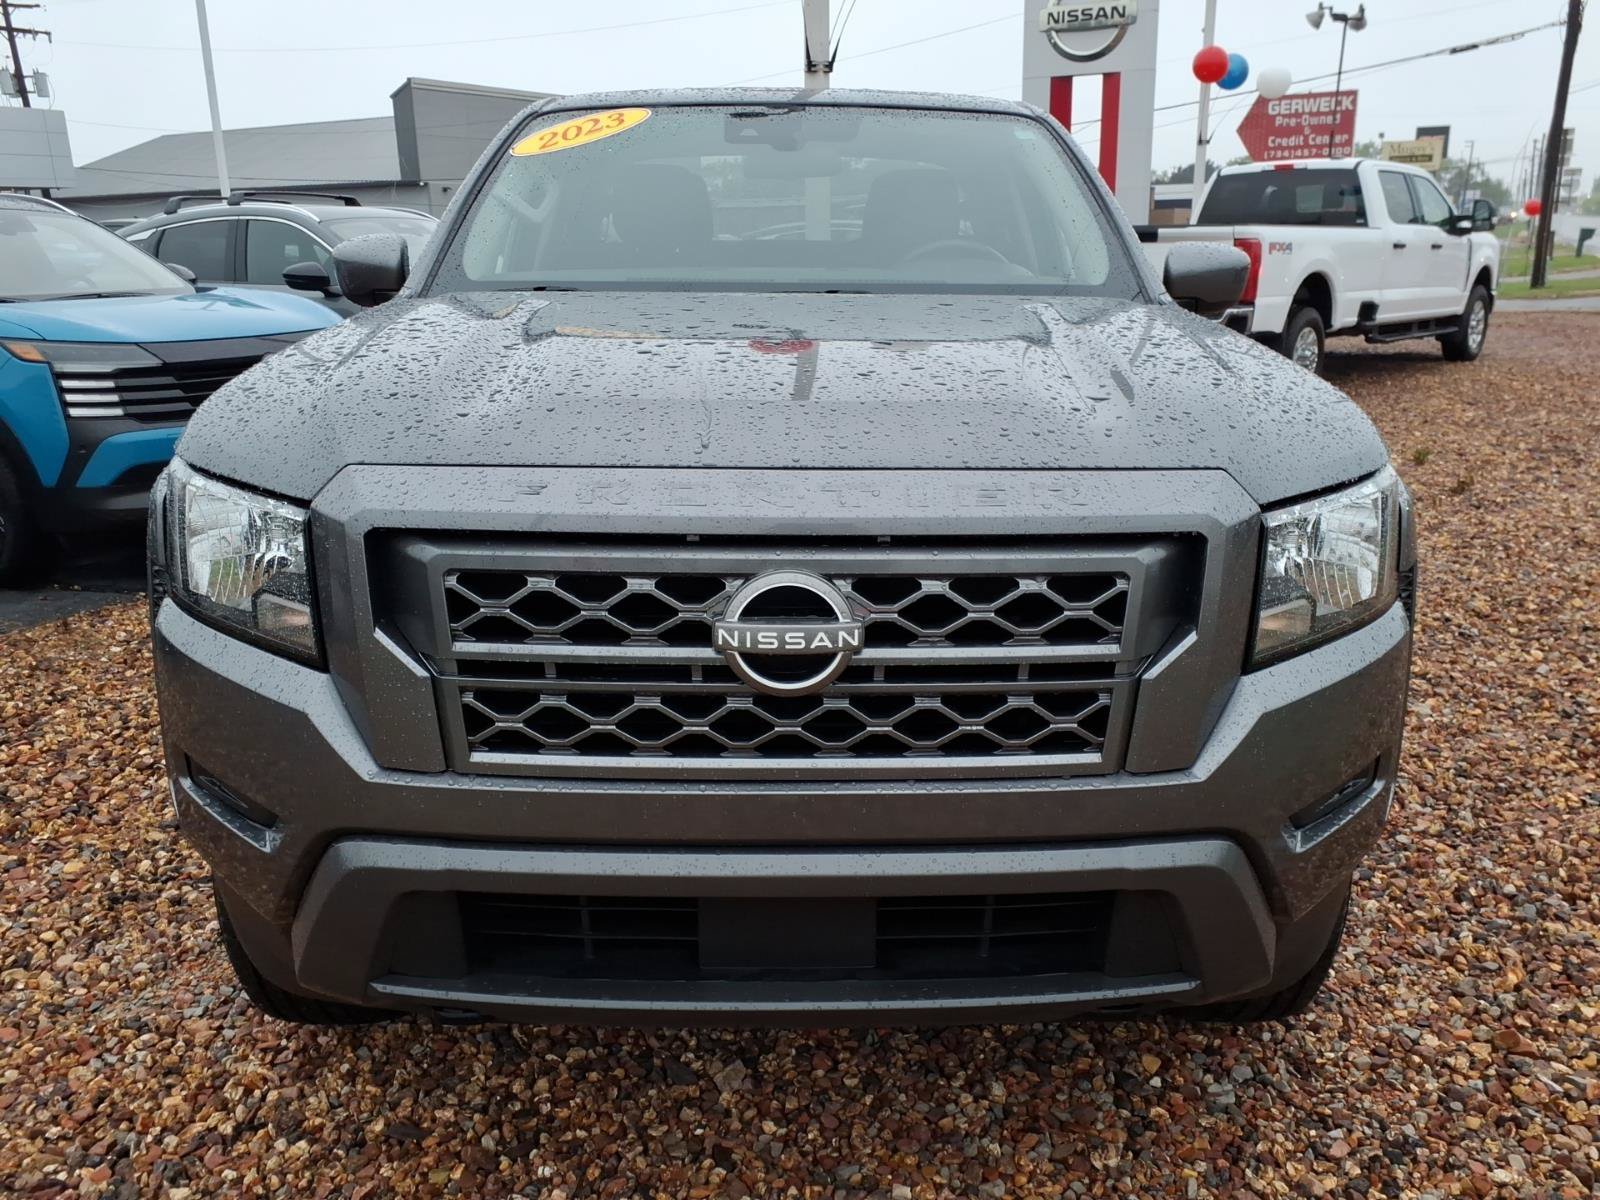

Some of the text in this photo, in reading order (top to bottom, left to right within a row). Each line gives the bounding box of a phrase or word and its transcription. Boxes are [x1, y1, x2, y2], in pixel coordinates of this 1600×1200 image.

[1047, 5, 1126, 25] NISSAN
[538, 112, 626, 150] 2023
[1267, 133, 1349, 147] Credit Cener
[717, 628, 860, 650] NISSAN
